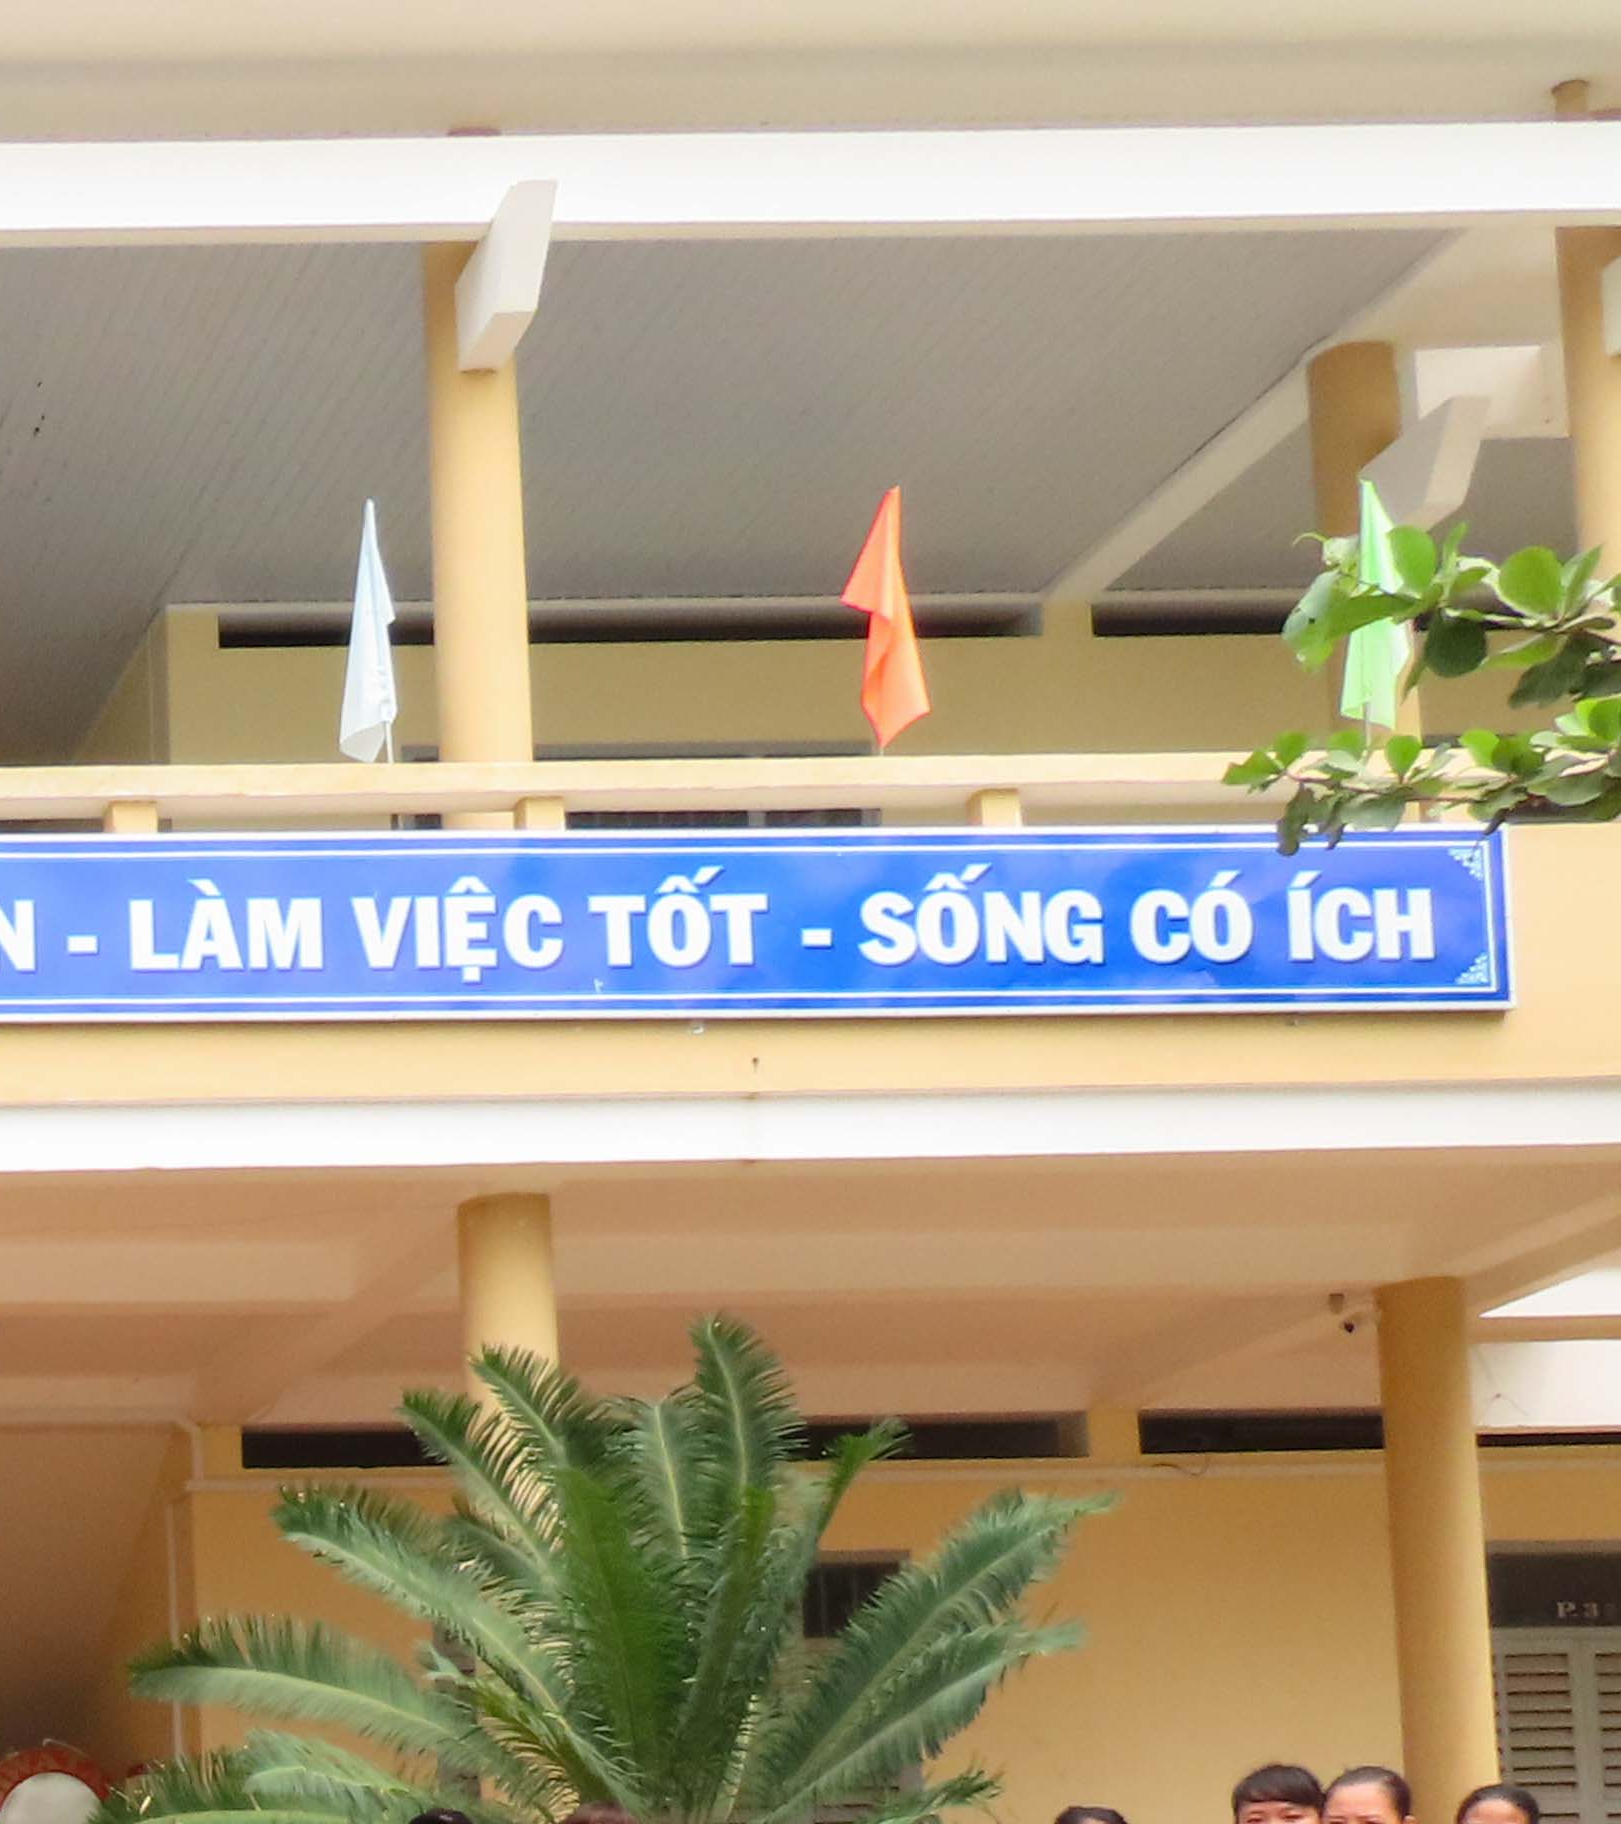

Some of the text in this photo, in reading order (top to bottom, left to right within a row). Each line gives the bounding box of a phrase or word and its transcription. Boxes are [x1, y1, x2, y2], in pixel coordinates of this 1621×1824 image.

[67, 935, 99, 955] -
[129, 878, 324, 971] LÀM
[352, 875, 564, 984] VIỆC
[588, 865, 769, 967] TỐT
[801, 928, 833, 948] -
[858, 864, 1105, 965] SỐNG
[1131, 871, 1254, 964] CÓ
[1287, 871, 1436, 962] ÍCH
